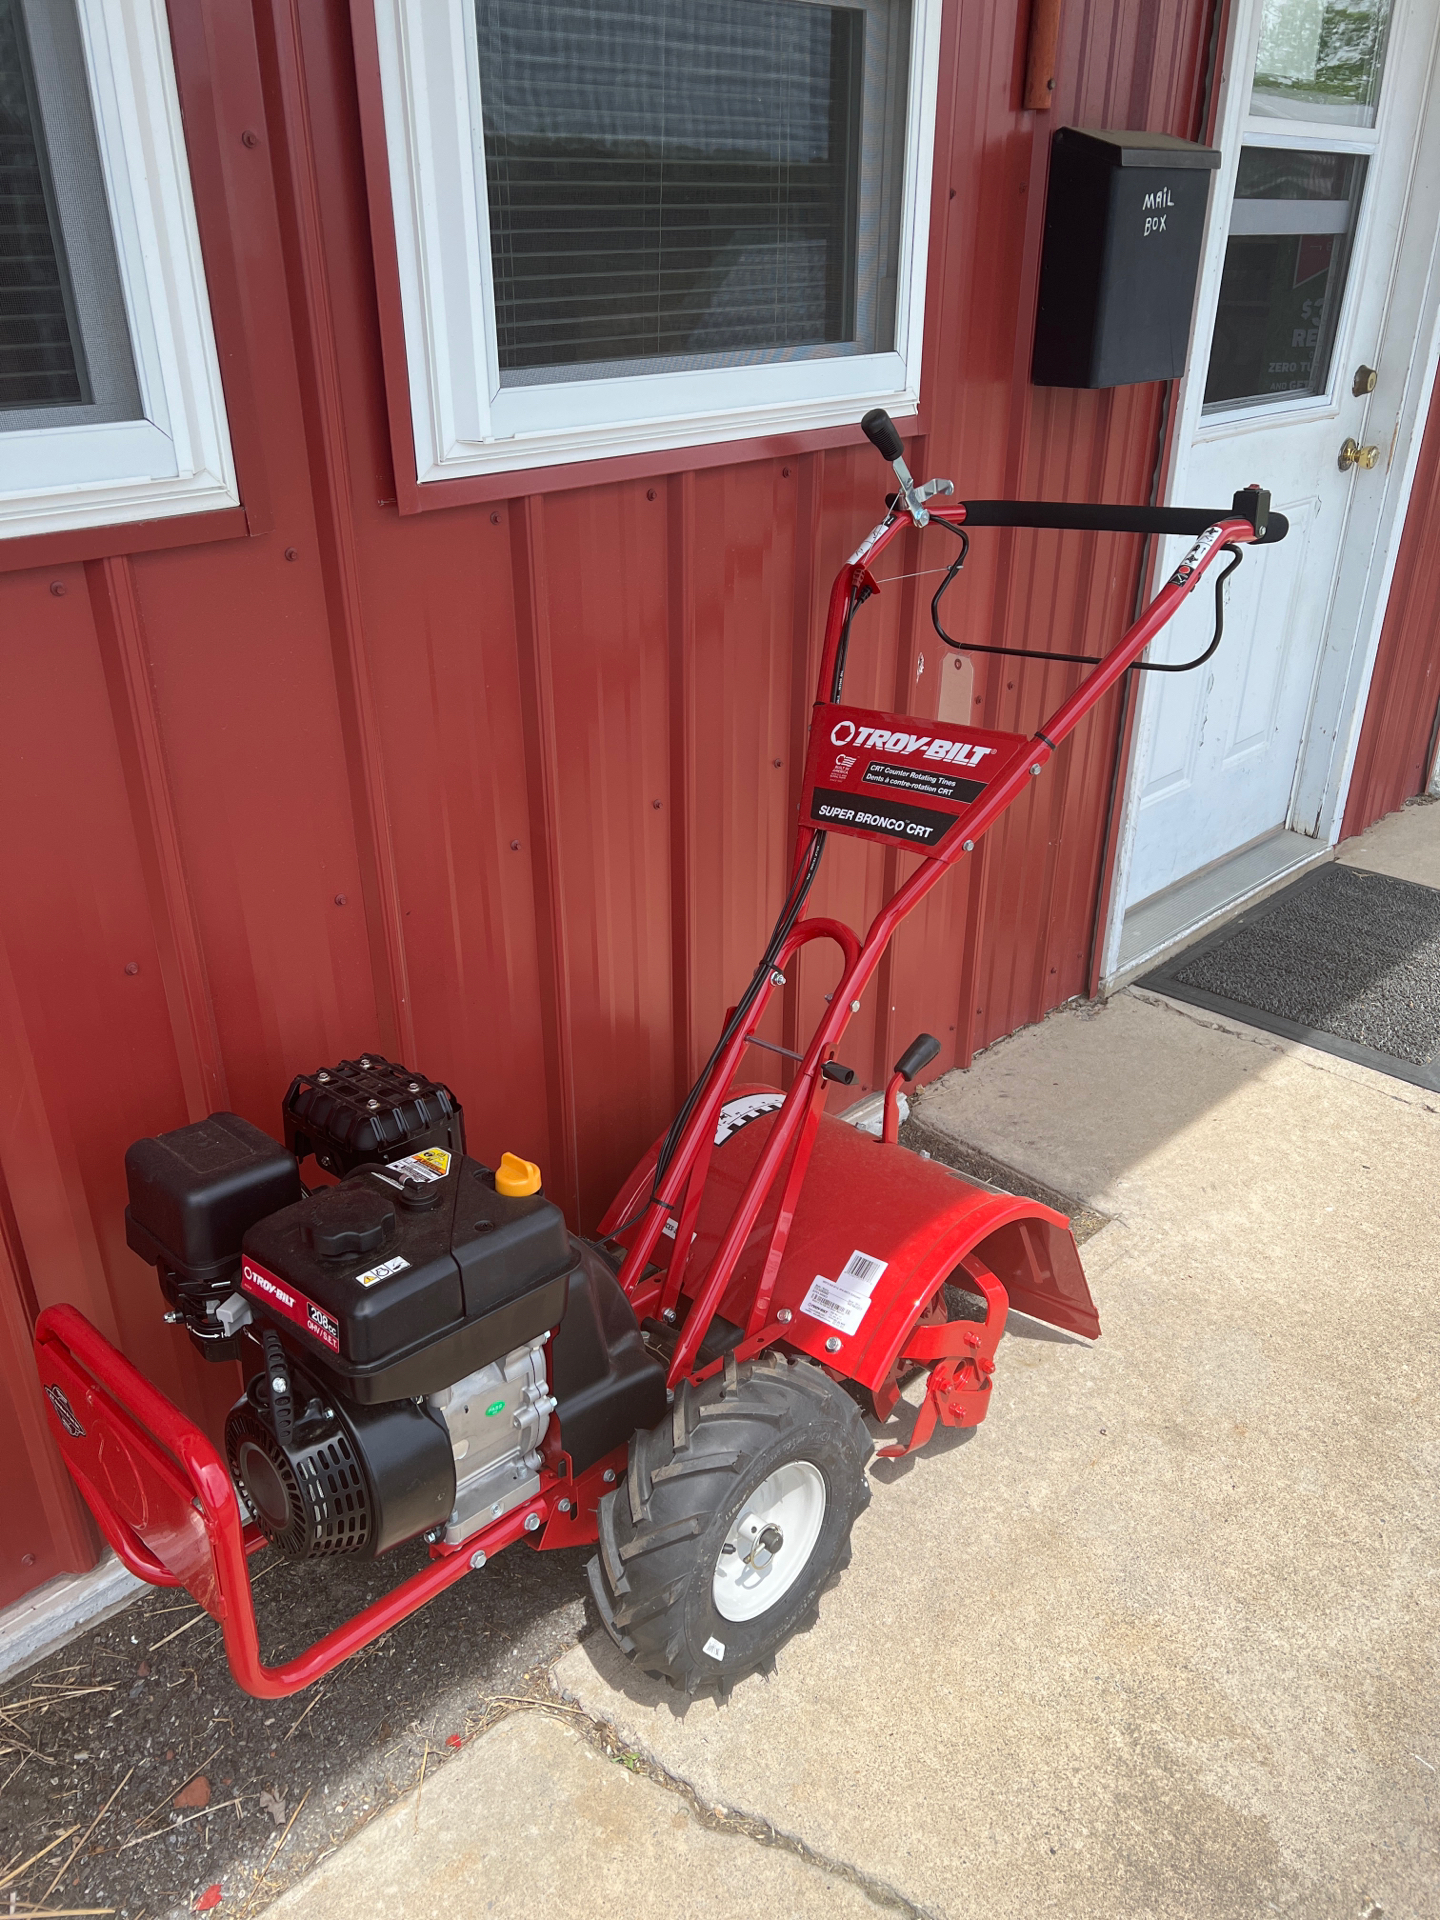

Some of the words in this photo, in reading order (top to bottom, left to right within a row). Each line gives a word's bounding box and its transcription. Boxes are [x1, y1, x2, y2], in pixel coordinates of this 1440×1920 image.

[1143, 213, 1167, 237] BOX
[1301, 298, 1325, 327] $3
[1291, 328, 1319, 347] RE
[1268, 362, 1297, 373] ZERO
[1300, 361, 1313, 372] TU
[1270, 382, 1287, 390] AND
[852, 726, 992, 768] TROY-BILT
[866, 773, 883, 783] Dents
[889, 778, 937, 793] contre-rotation
[938, 787, 954, 797] CRT
[870, 764, 884, 773] CRT
[884, 767, 909, 777] Counter
[909, 771, 937, 783] Rotating
[937, 775, 957, 787] Tines
[818, 805, 855, 821] SUPER
[855, 812, 904, 832] BRONCO
[906, 824, 933, 838] CRT
[251, 1272, 295, 1308] TROY-BILT
[306, 1320, 320, 1336] OHV
[488, 1402, 503, 1413] PASS
